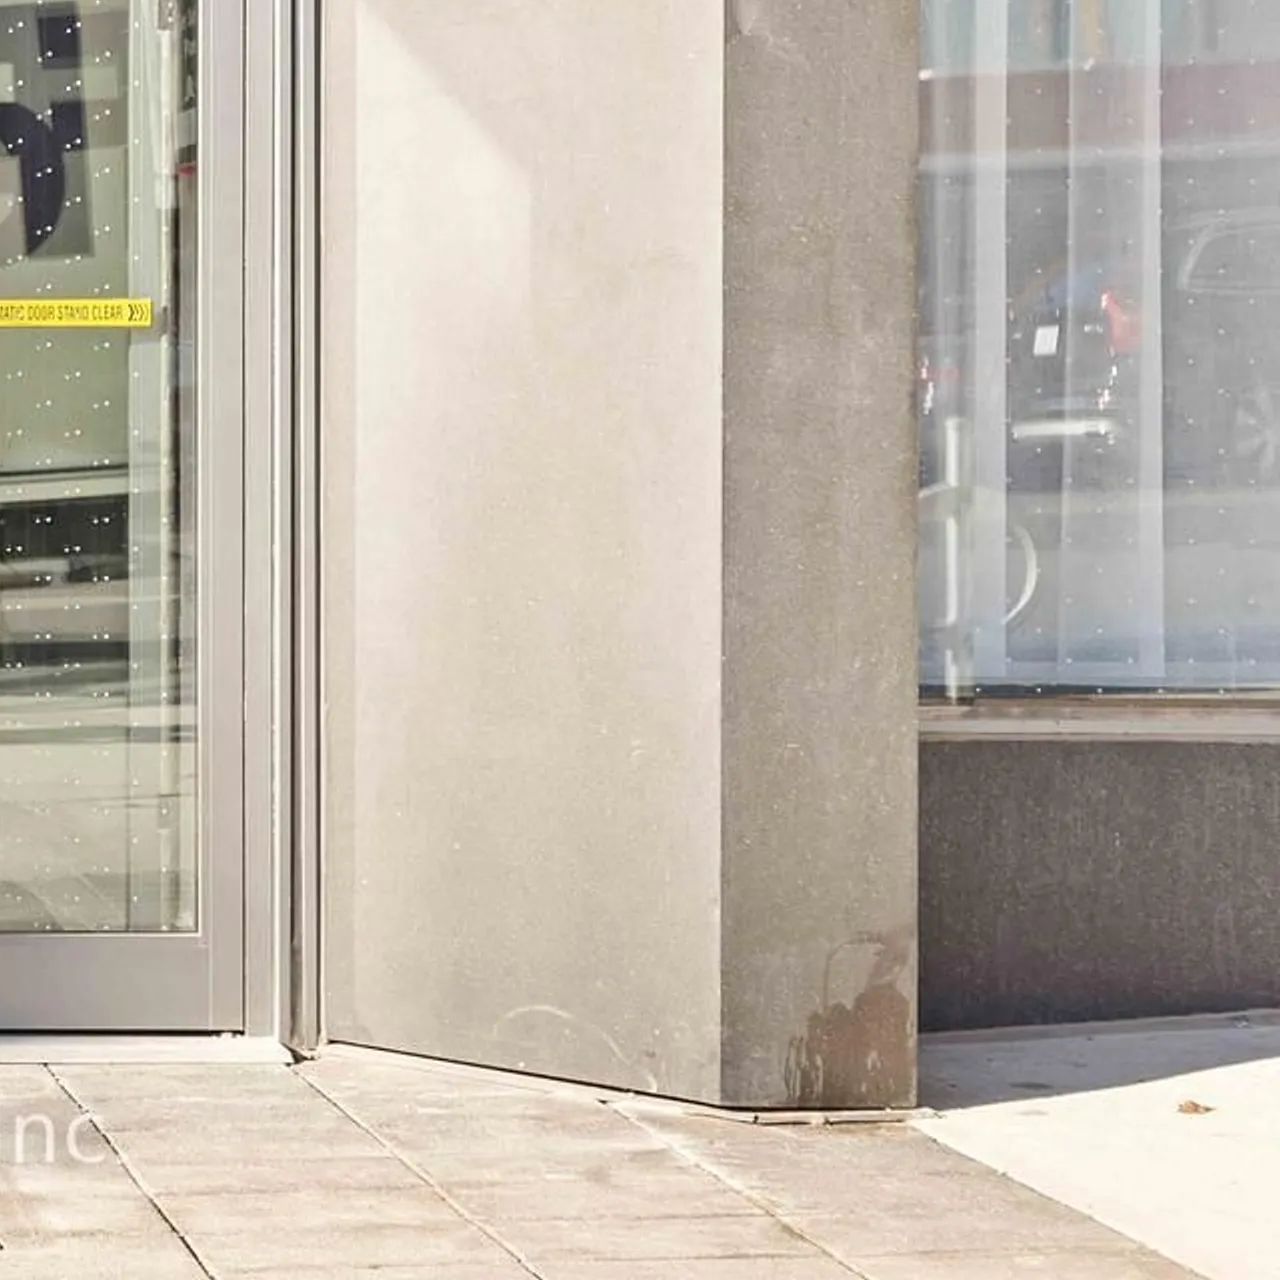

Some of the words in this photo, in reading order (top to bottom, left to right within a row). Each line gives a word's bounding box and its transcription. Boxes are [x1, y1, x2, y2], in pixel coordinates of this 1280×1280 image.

[27, 304, 55, 321] DOOR
[58, 304, 89, 321] STAND
[92, 304, 124, 321] CLEAR
